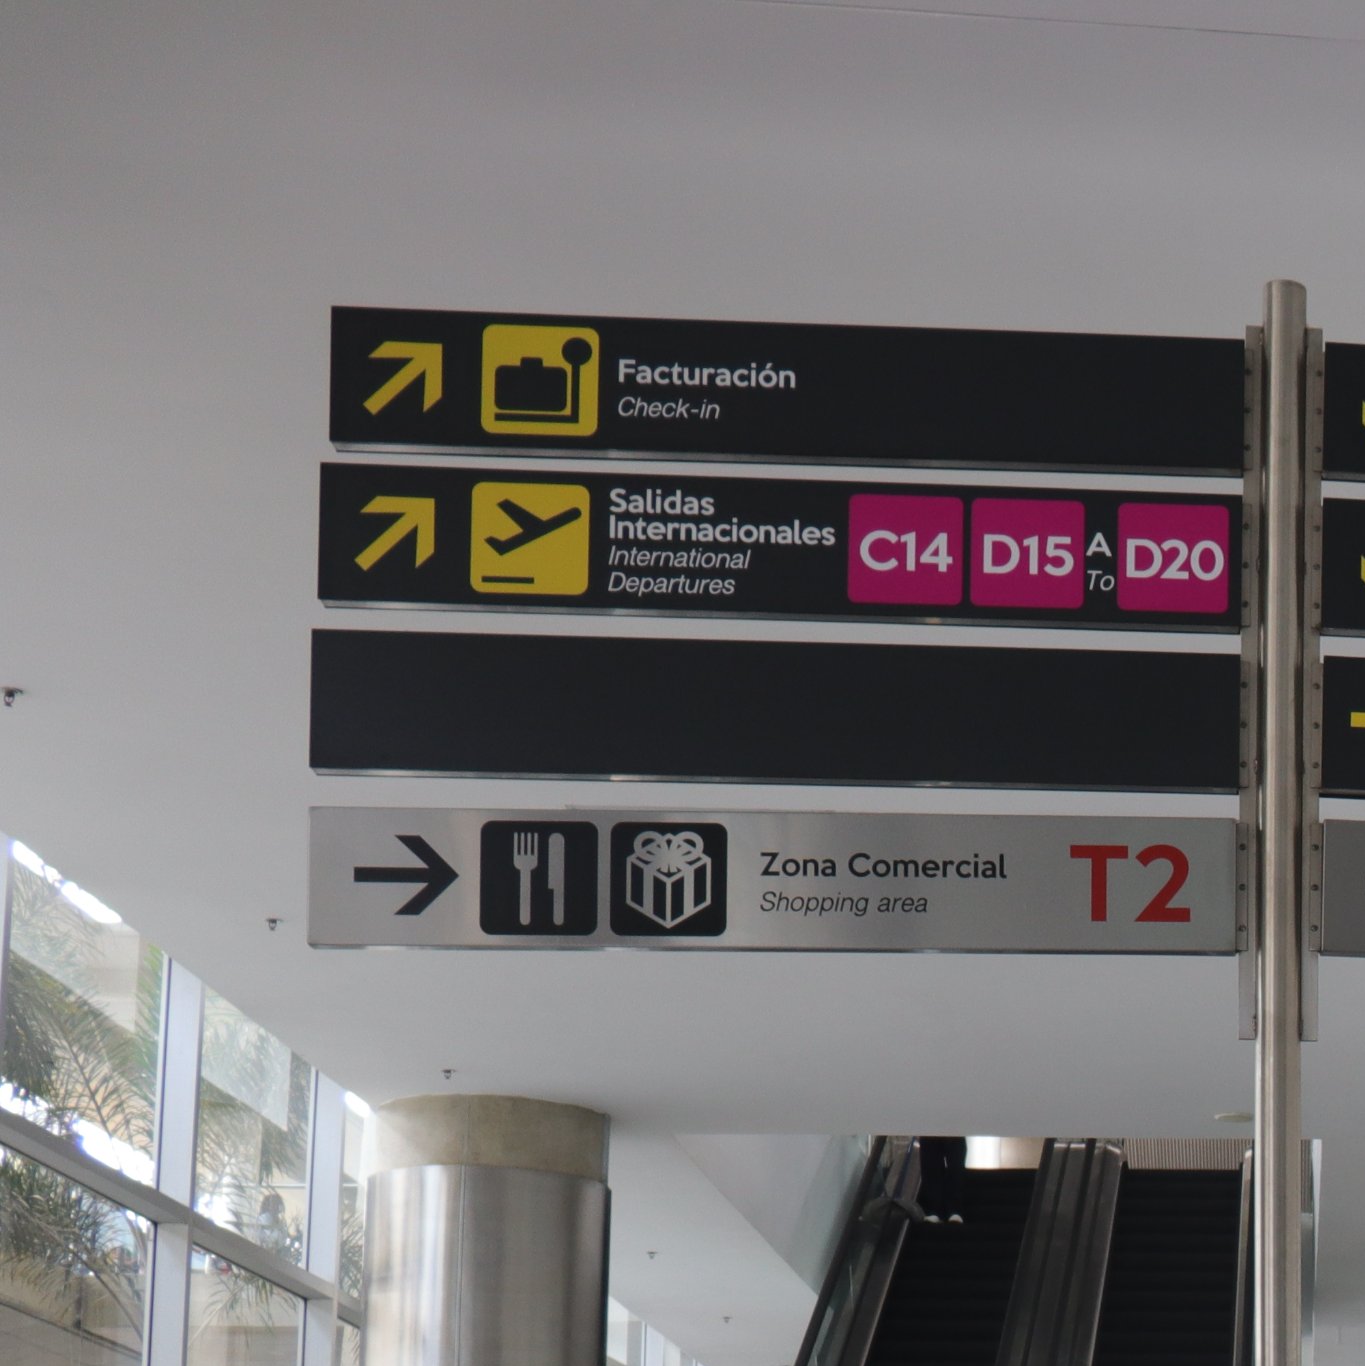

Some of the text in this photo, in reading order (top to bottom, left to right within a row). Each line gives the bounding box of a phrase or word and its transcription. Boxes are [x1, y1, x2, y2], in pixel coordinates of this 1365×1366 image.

[618, 358, 796, 389] Facturación
[617, 396, 721, 419] Check-in
[609, 488, 715, 515] Salidas
[609, 514, 836, 546] Internacionales
[608, 545, 751, 569] International
[859, 529, 953, 573] C14
[982, 533, 1075, 577] D15
[1085, 531, 1112, 558] A
[1125, 537, 1224, 581] D20
[608, 571, 736, 597] Departures
[1086, 569, 1115, 592] To
[760, 852, 1007, 880] Zona Comercial
[1069, 844, 1191, 923] T2
[759, 890, 929, 917] Shopping area
